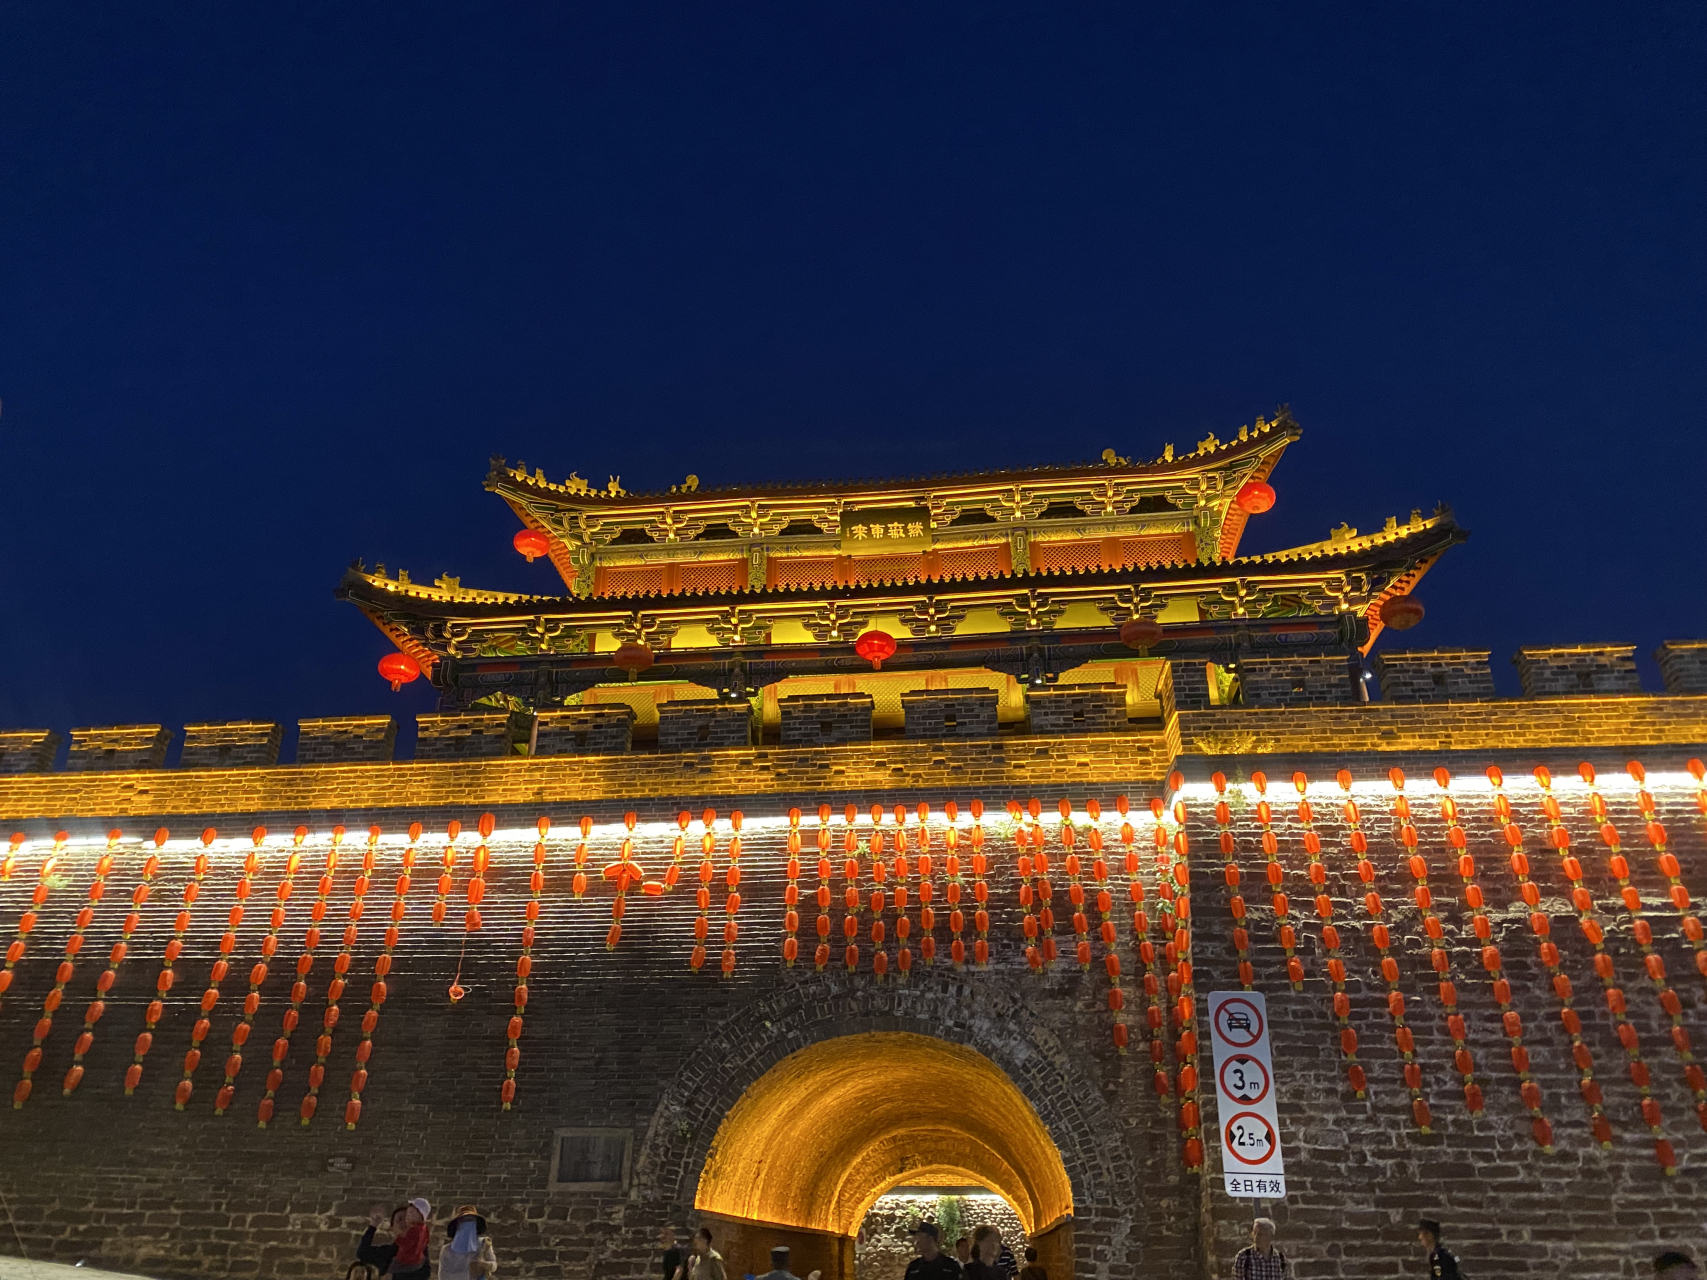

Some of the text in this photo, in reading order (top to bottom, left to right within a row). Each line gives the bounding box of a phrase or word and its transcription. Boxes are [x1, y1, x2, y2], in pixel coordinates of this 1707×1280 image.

[1236, 1124, 1264, 1147] 2.5m
[1229, 1178, 1282, 1193] 全日有效
